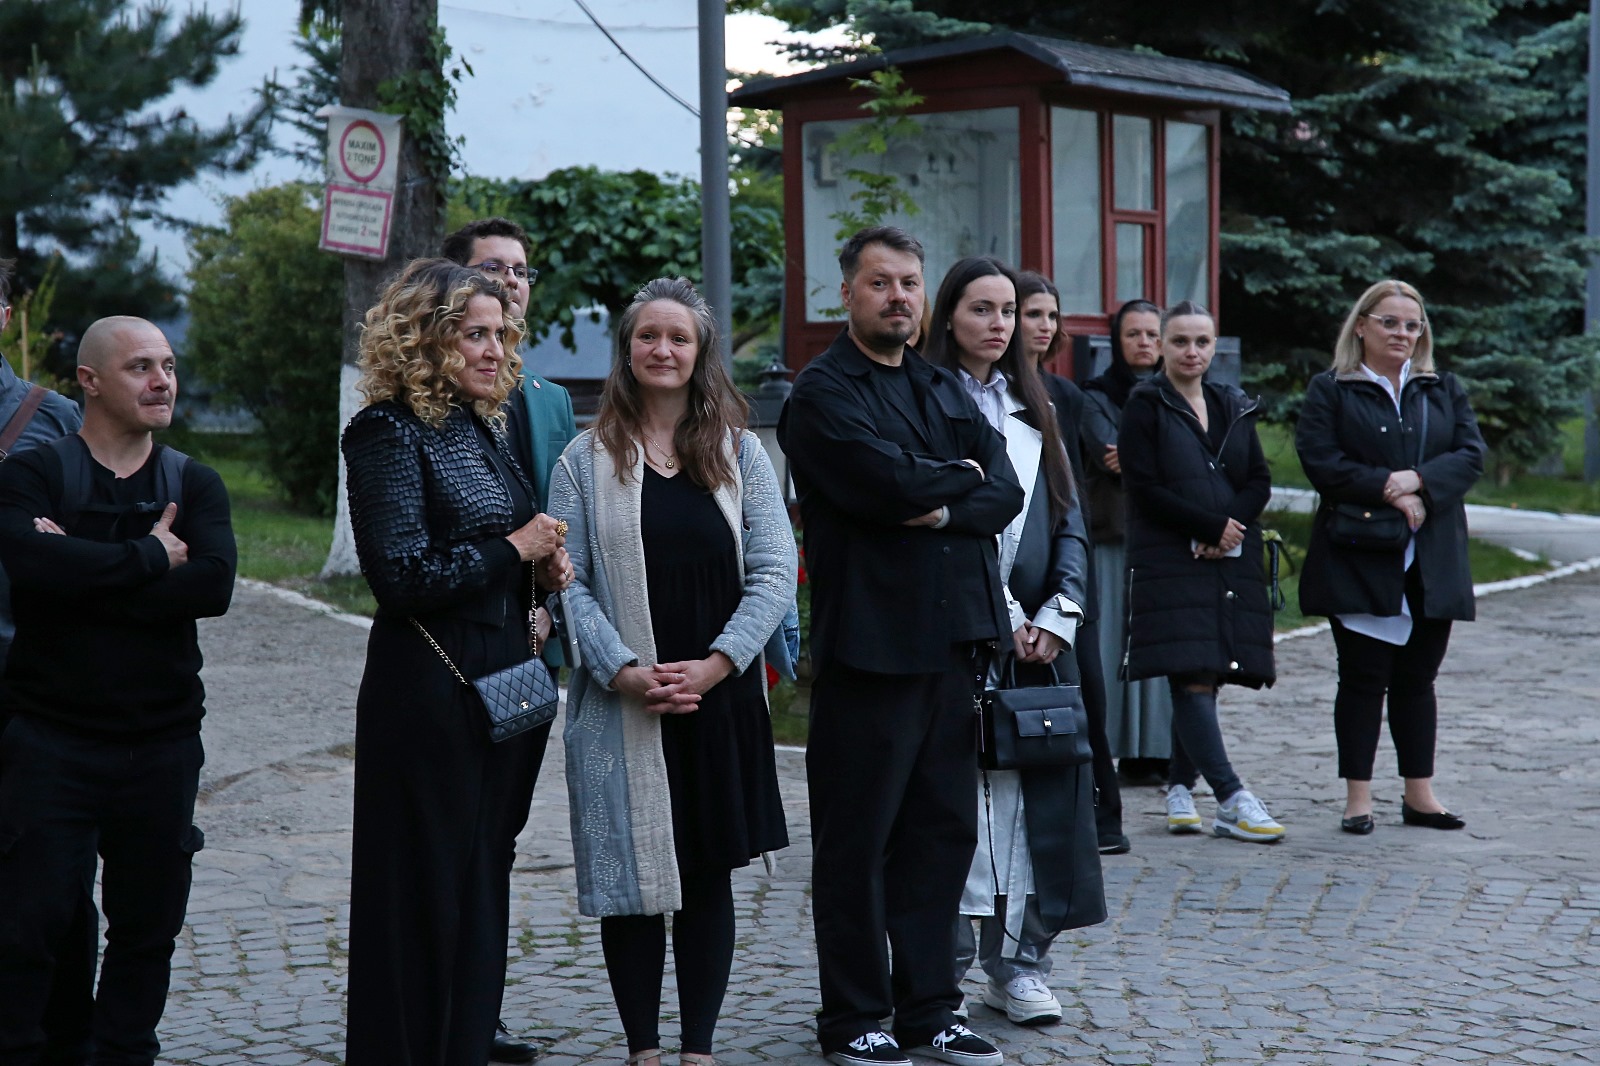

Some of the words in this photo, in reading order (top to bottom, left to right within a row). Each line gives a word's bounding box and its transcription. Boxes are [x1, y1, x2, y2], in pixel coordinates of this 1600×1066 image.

[348, 139, 376, 151] MAXIM
[347, 151, 352, 161] 2
[354, 152, 377, 165] TONE
[360, 225, 367, 237] 2
